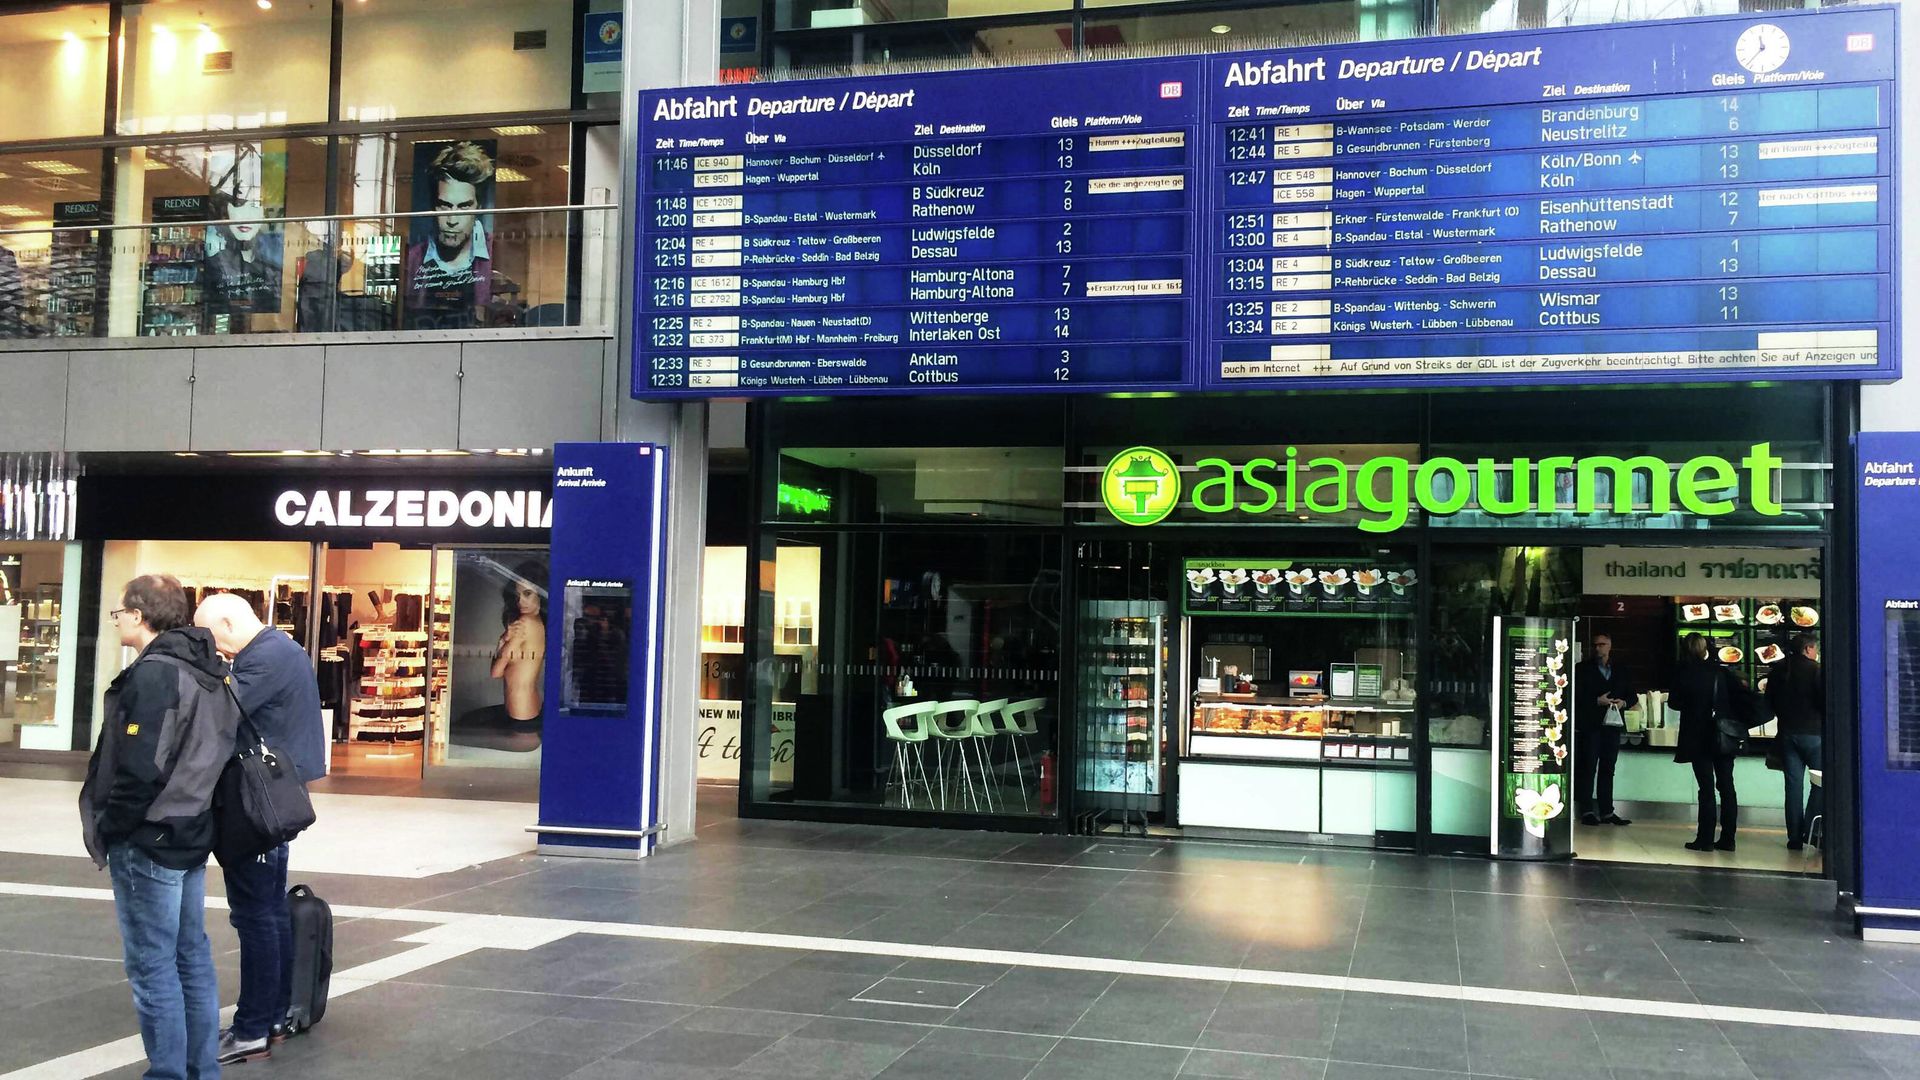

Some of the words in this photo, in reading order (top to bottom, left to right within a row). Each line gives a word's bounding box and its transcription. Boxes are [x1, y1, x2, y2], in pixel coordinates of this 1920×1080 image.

[1225, 58, 1325, 87] Abfahrt
[1338, 56, 1444, 82] Departure
[1466, 48, 1543, 72] Départ
[1163, 85, 1178, 96] DB
[1543, 85, 1566, 97] Ziel
[1574, 82, 1630, 95] Destination
[1712, 74, 1745, 86] Gleis
[1754, 71, 1824, 84] Platform/Voie
[653, 96, 737, 121] Abfahrt
[747, 96, 835, 118] Departure
[852, 89, 914, 110] Départ
[1228, 106, 1249, 118] Zeit
[1256, 104, 1310, 116] Time/Temps
[1336, 98, 1364, 111] Über
[1371, 99, 1385, 109] Via
[656, 139, 674, 149] Zeit
[679, 138, 724, 148] Time/Temps
[746, 133, 769, 145] Über
[914, 125, 933, 136] Ziel
[940, 124, 985, 134] Destination
[1051, 117, 1078, 128] Gleis
[1085, 114, 1142, 126] Platform/Voie
[1230, 128, 1265, 141] 12:41
[1337, 125, 1391, 136] B-Wannsee
[1400, 122, 1444, 133] Potsdam
[1453, 118, 1490, 129] Werder
[1542, 106, 1639, 123] Brandenburg
[1720, 98, 1738, 111] 14
[1230, 146, 1265, 159] 12:44
[1337, 145, 1343, 154] B
[1347, 141, 1420, 153] Gesundbrunnen
[1429, 137, 1490, 149] Fürstenberg
[1542, 125, 1627, 142] Neustrelitz
[1729, 118, 1739, 131] 6
[656, 158, 687, 170] 11:46
[746, 157, 782, 167] Hannover
[790, 156, 821, 165] Bochum
[828, 153, 874, 163] Düsseldorf
[914, 143, 981, 158] Düsseldorf
[1058, 139, 1073, 150] 13
[1230, 173, 1265, 185] 12:47
[1297, 171, 1314, 180] 548
[1541, 152, 1622, 168] Köln/Bonn
[1720, 145, 1738, 158] 13
[746, 174, 770, 184] Hagen
[778, 172, 819, 182] Wuppertal
[913, 163, 940, 175] Köln
[1057, 156, 1072, 168] 13
[1541, 174, 1574, 188] Köln
[1720, 165, 1738, 178] 13
[164, 198, 200, 208] REDKEN
[656, 198, 686, 210] 11:48
[913, 188, 920, 199] B
[926, 186, 984, 198] Südkreuz
[1064, 181, 1072, 193] 2
[656, 215, 686, 226] 12:00
[745, 214, 787, 224] B-Spandau
[794, 212, 817, 222] Elstal
[825, 211, 876, 220] Wustermark
[913, 204, 974, 216] Rathenow
[1064, 198, 1072, 210] 8
[1228, 215, 1264, 228] 12:51
[1335, 214, 1367, 224] Erkner
[1376, 210, 1444, 222] Fürstenwalde
[1452, 208, 1500, 218] Frankfurt
[1540, 194, 1673, 215] Eisenhüttenstadt
[1720, 192, 1738, 206] 12
[655, 238, 686, 250] 12:04
[912, 227, 995, 242] Ludwigsfelde
[1064, 223, 1071, 235] 2
[1228, 233, 1265, 246] 13:00
[1540, 218, 1617, 233] Rathenow
[1729, 212, 1738, 225] 7
[655, 255, 686, 266] 12:15
[744, 254, 795, 264] P-Rehbrücke
[802, 253, 828, 262] Seddin
[835, 252, 851, 261] Bad
[855, 251, 879, 262] Belzig
[912, 246, 957, 258] Dessau
[1056, 241, 1071, 253] 13
[1228, 259, 1264, 272] 13:04
[1540, 244, 1643, 261] Ludwigsfelde
[1732, 240, 1738, 252] 1
[654, 279, 684, 290] 12:16
[911, 269, 1014, 284] Hamburg-Altona
[1063, 266, 1070, 277] 7
[1228, 277, 1264, 290] 13:15
[1540, 265, 1596, 279] Dessau
[1720, 259, 1738, 272] 13
[653, 295, 684, 306] 12:16
[911, 286, 1014, 301] Hamburg-Altona
[1063, 283, 1070, 295] 7
[1227, 303, 1263, 315] 13:25
[1334, 302, 1385, 314] B-Spandau
[1394, 300, 1440, 312] Wittenbg.
[1450, 299, 1496, 310] Schwerin
[1539, 293, 1600, 306] Wismar
[1719, 287, 1738, 300] 13
[653, 318, 683, 330] 12:25
[910, 311, 988, 325] Wittenberge
[1054, 308, 1070, 320] 13
[1227, 321, 1263, 333] 13:34
[1539, 311, 1600, 325] Cottbus
[1720, 307, 1738, 319] 11
[652, 335, 683, 346] 12:32
[741, 335, 792, 344] Frankfurt(M)
[796, 334, 810, 343] Hbf
[817, 334, 857, 343] Mannheim
[864, 333, 898, 344] Freiburg
[909, 328, 973, 341] Interlaken
[979, 328, 1000, 339] Ost
[1054, 325, 1069, 337] 14
[652, 358, 682, 370] 12:33
[910, 354, 958, 365] Anklam
[1061, 352, 1069, 362] 3
[1224, 365, 1245, 374] auch
[1263, 363, 1300, 373] Internet
[1341, 362, 1358, 371] Auf
[1362, 361, 1390, 371] Grund
[1394, 361, 1411, 370] von
[1416, 359, 1452, 370] Streiks
[1477, 358, 1497, 368] GDL
[1542, 357, 1600, 369] Zugverkehr
[1688, 354, 1714, 365] Bitte
[1805, 349, 1855, 363] Anzeigen
[652, 375, 682, 386] 12:33
[909, 371, 958, 382] Cottbus
[1054, 369, 1069, 380] 12
[557, 468, 593, 476] Ankunft
[1865, 462, 1913, 473] Abfahrt
[557, 479, 580, 487] Arrival
[1191, 441, 1782, 533] asiagourmet
[1864, 477, 1916, 487] Departure
[1605, 560, 1685, 578] thailand
[1618, 602, 1624, 611] 2
[1885, 600, 1918, 608] Abfahrt
[704, 661, 720, 678] 13
[699, 710, 722, 718] NEW
